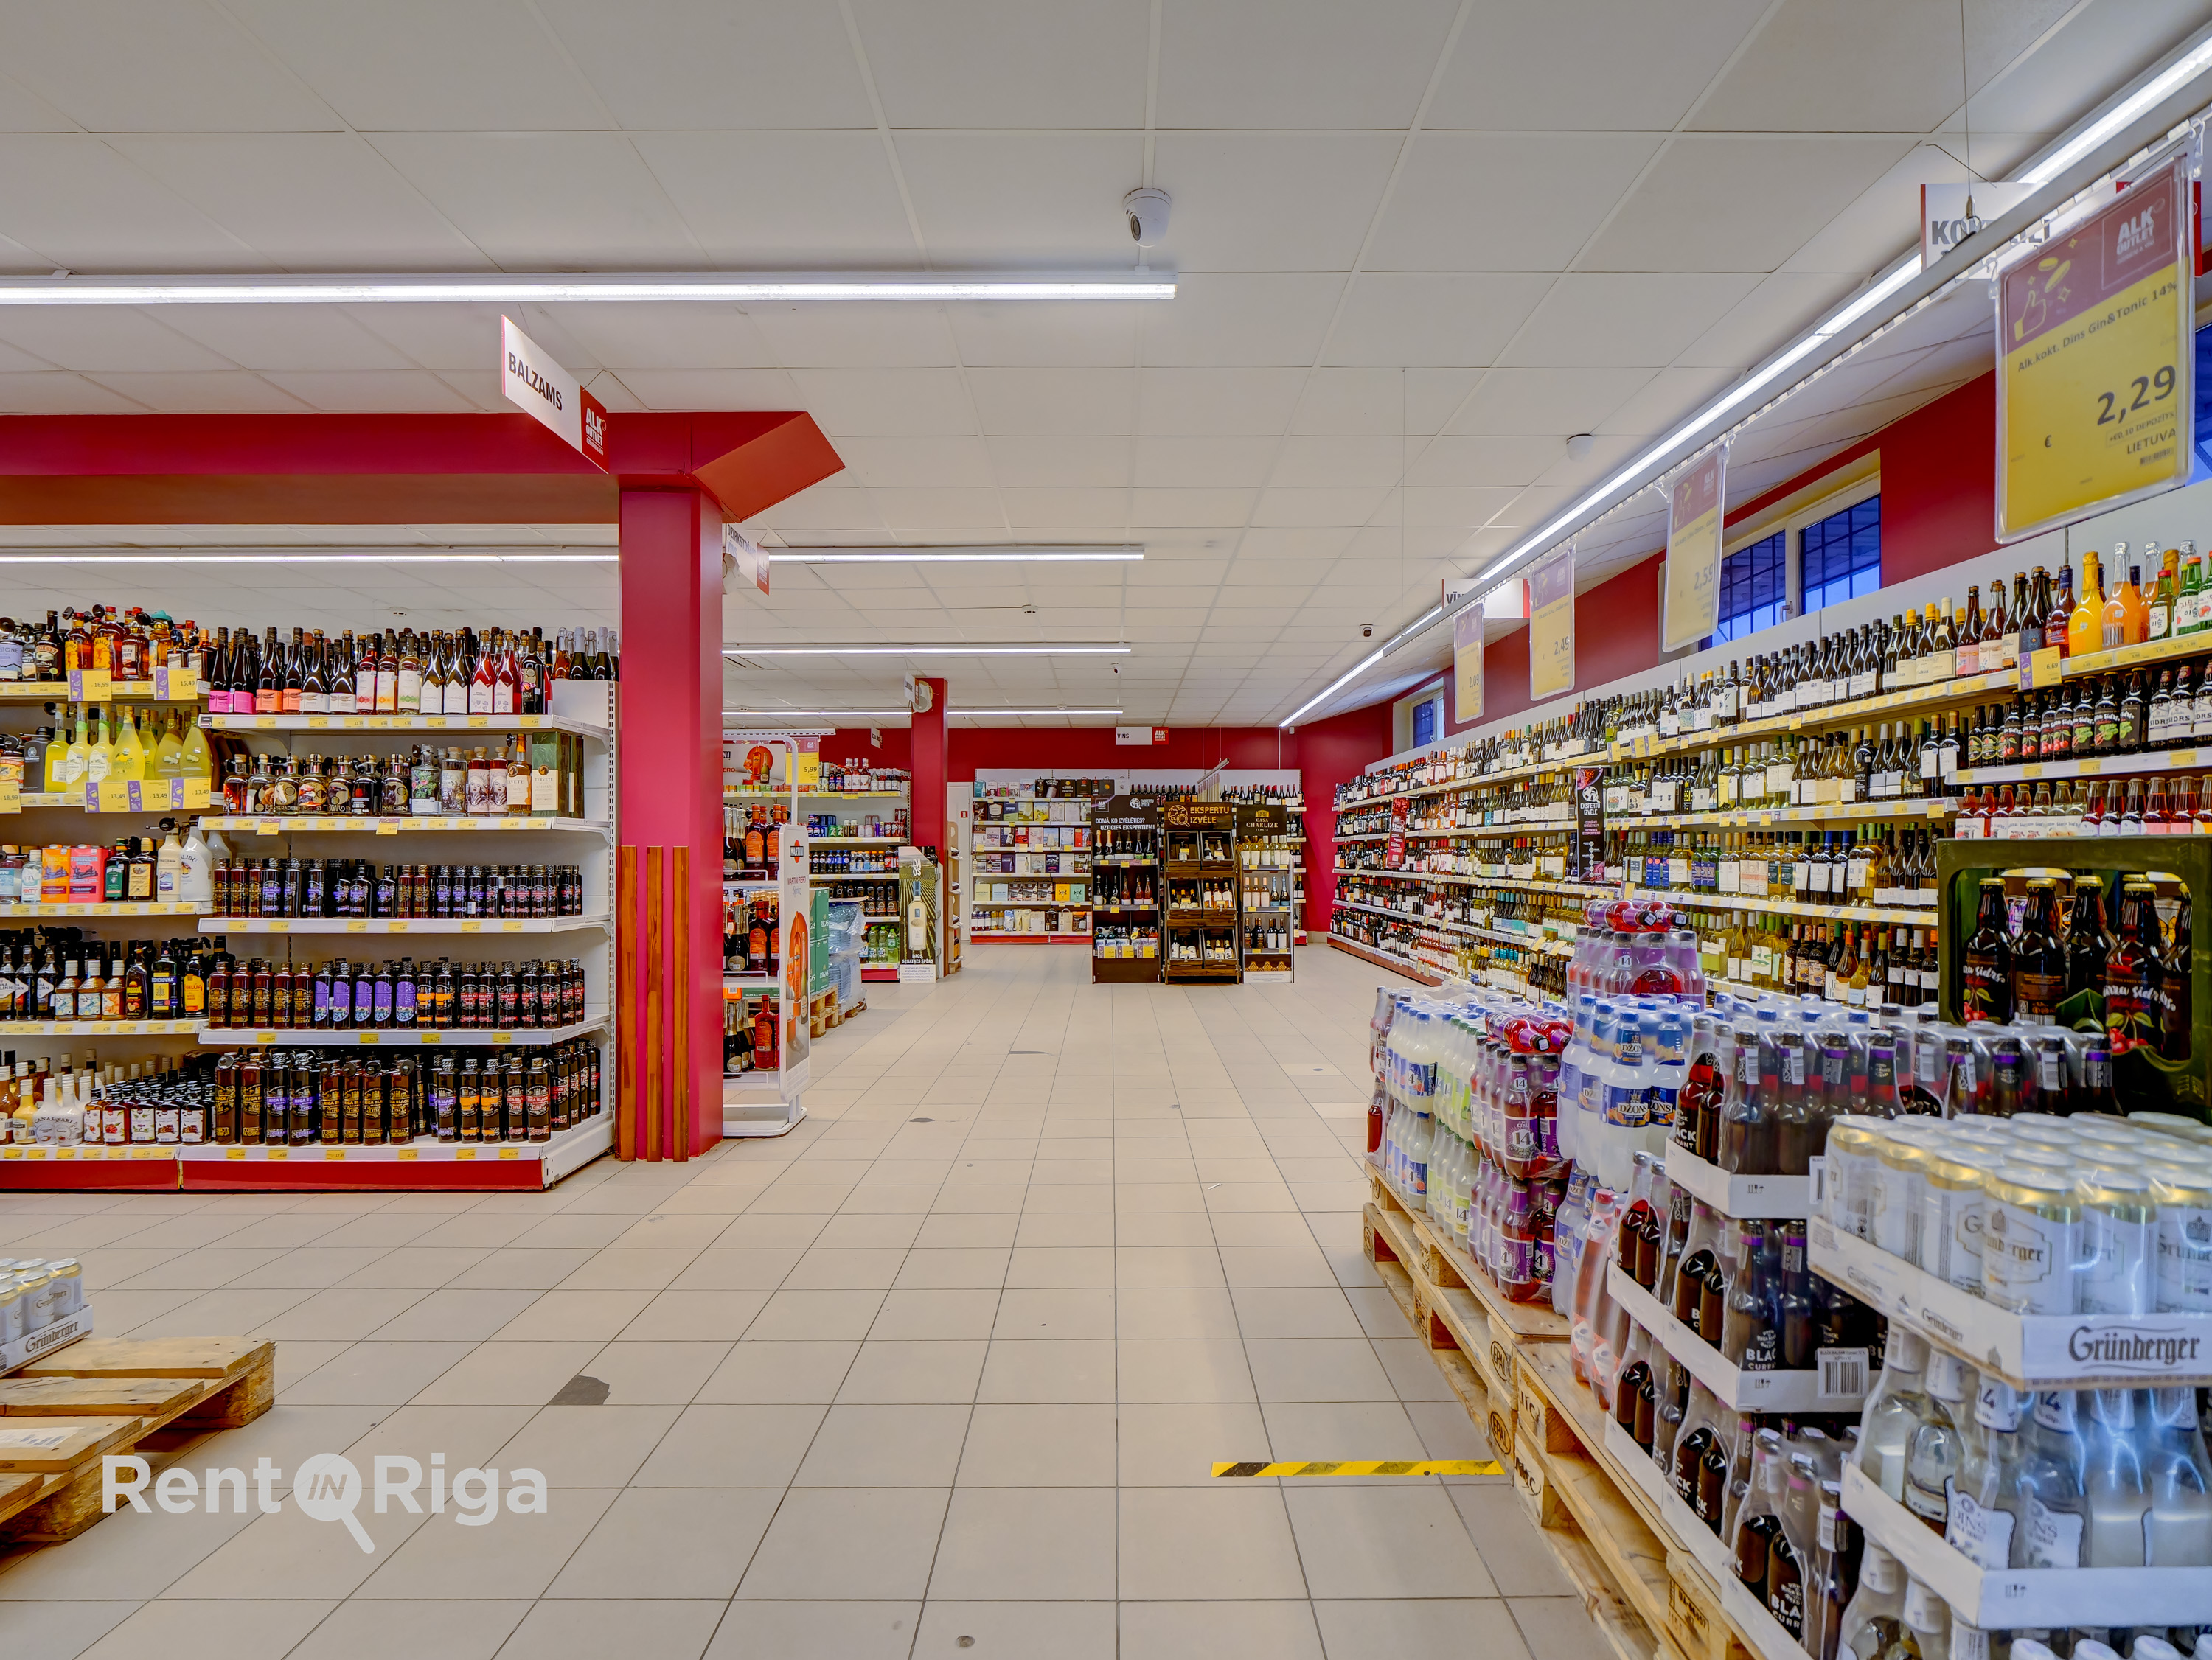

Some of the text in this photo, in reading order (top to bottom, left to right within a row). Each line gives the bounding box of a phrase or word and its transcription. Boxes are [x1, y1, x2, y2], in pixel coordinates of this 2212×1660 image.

[2117, 206, 2154, 243] ALK
[2063, 331, 2085, 348] Dins
[509, 351, 563, 411] BALZAMS
[2097, 365, 2176, 426] 2,29
[585, 407, 603, 436] ALK
[2044, 435, 2052, 448] €
[2127, 428, 2177, 454] LIETUVA
[1554, 636, 1570, 655] 2,49
[2046, 662, 2059, 670] 6,69
[2168, 715, 2191, 723] SIDRS
[2197, 712, 2212, 720] DRS
[1190, 815, 1217, 823] IZVĒLE
[1621, 957, 1630, 966] 14
[1515, 1079, 1526, 1089] 14
[1619, 1103, 1648, 1112] DŽONS
[1676, 1128, 1697, 1142] ACK
[1676, 1137, 1694, 1149] RANT
[1456, 1207, 1469, 1221] 14
[26, 1321, 79, 1353] Grünberger
[2069, 1326, 2201, 1364] Grünberger
[1493, 1345, 1508, 1377] EPAL
[1748, 1362, 1775, 1370] CURR
[1492, 1415, 1509, 1450] EPAL
[2034, 1520, 2058, 1538] NS
[1771, 1594, 1802, 1619] BLA
[1773, 1611, 1800, 1629] CURR
